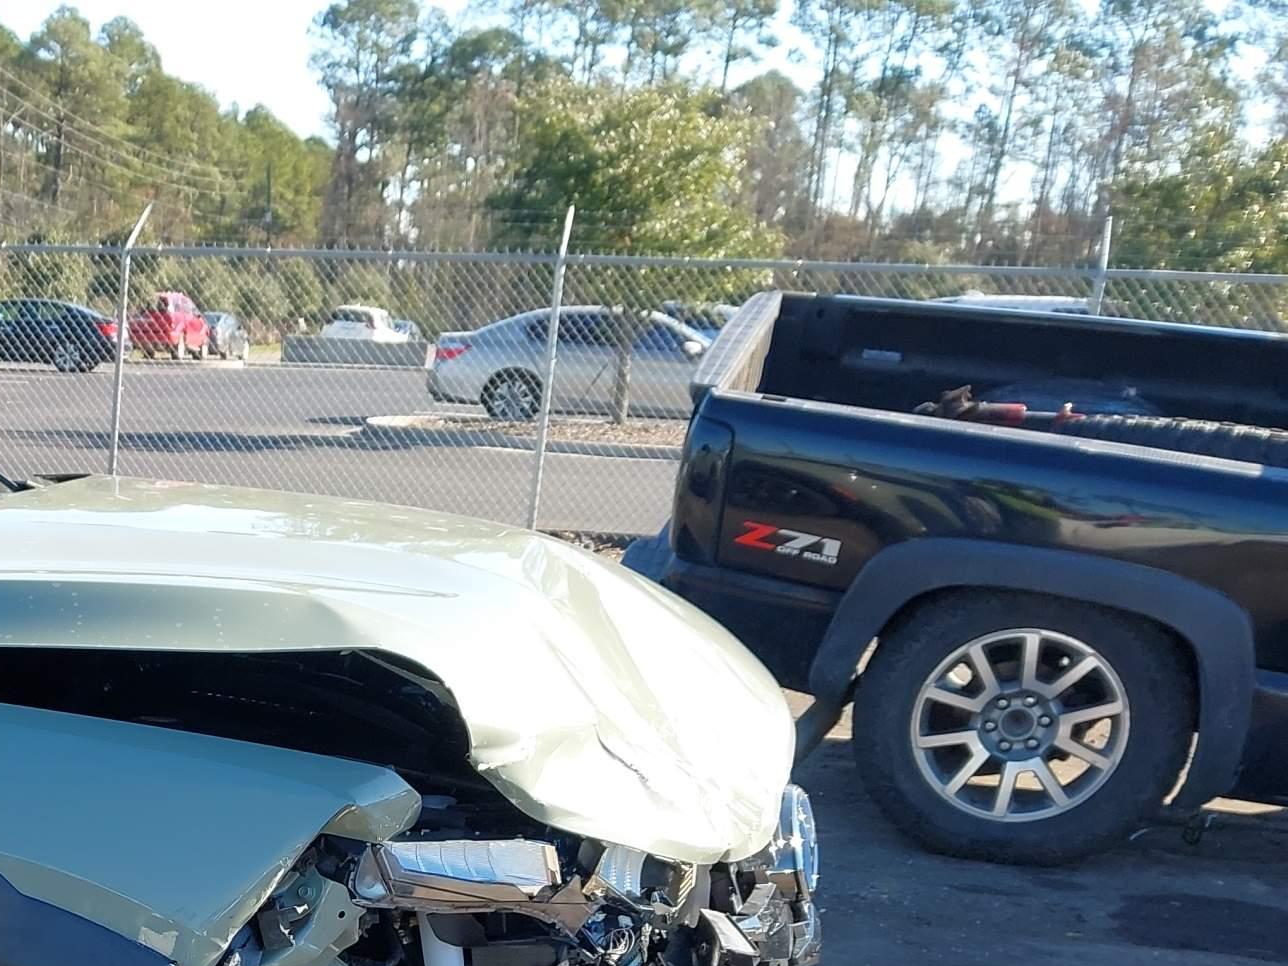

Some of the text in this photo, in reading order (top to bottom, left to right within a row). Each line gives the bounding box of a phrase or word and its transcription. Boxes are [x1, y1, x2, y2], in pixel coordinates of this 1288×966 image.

[733, 519, 842, 557] Z71
[775, 545, 839, 565] OFF ROAD
